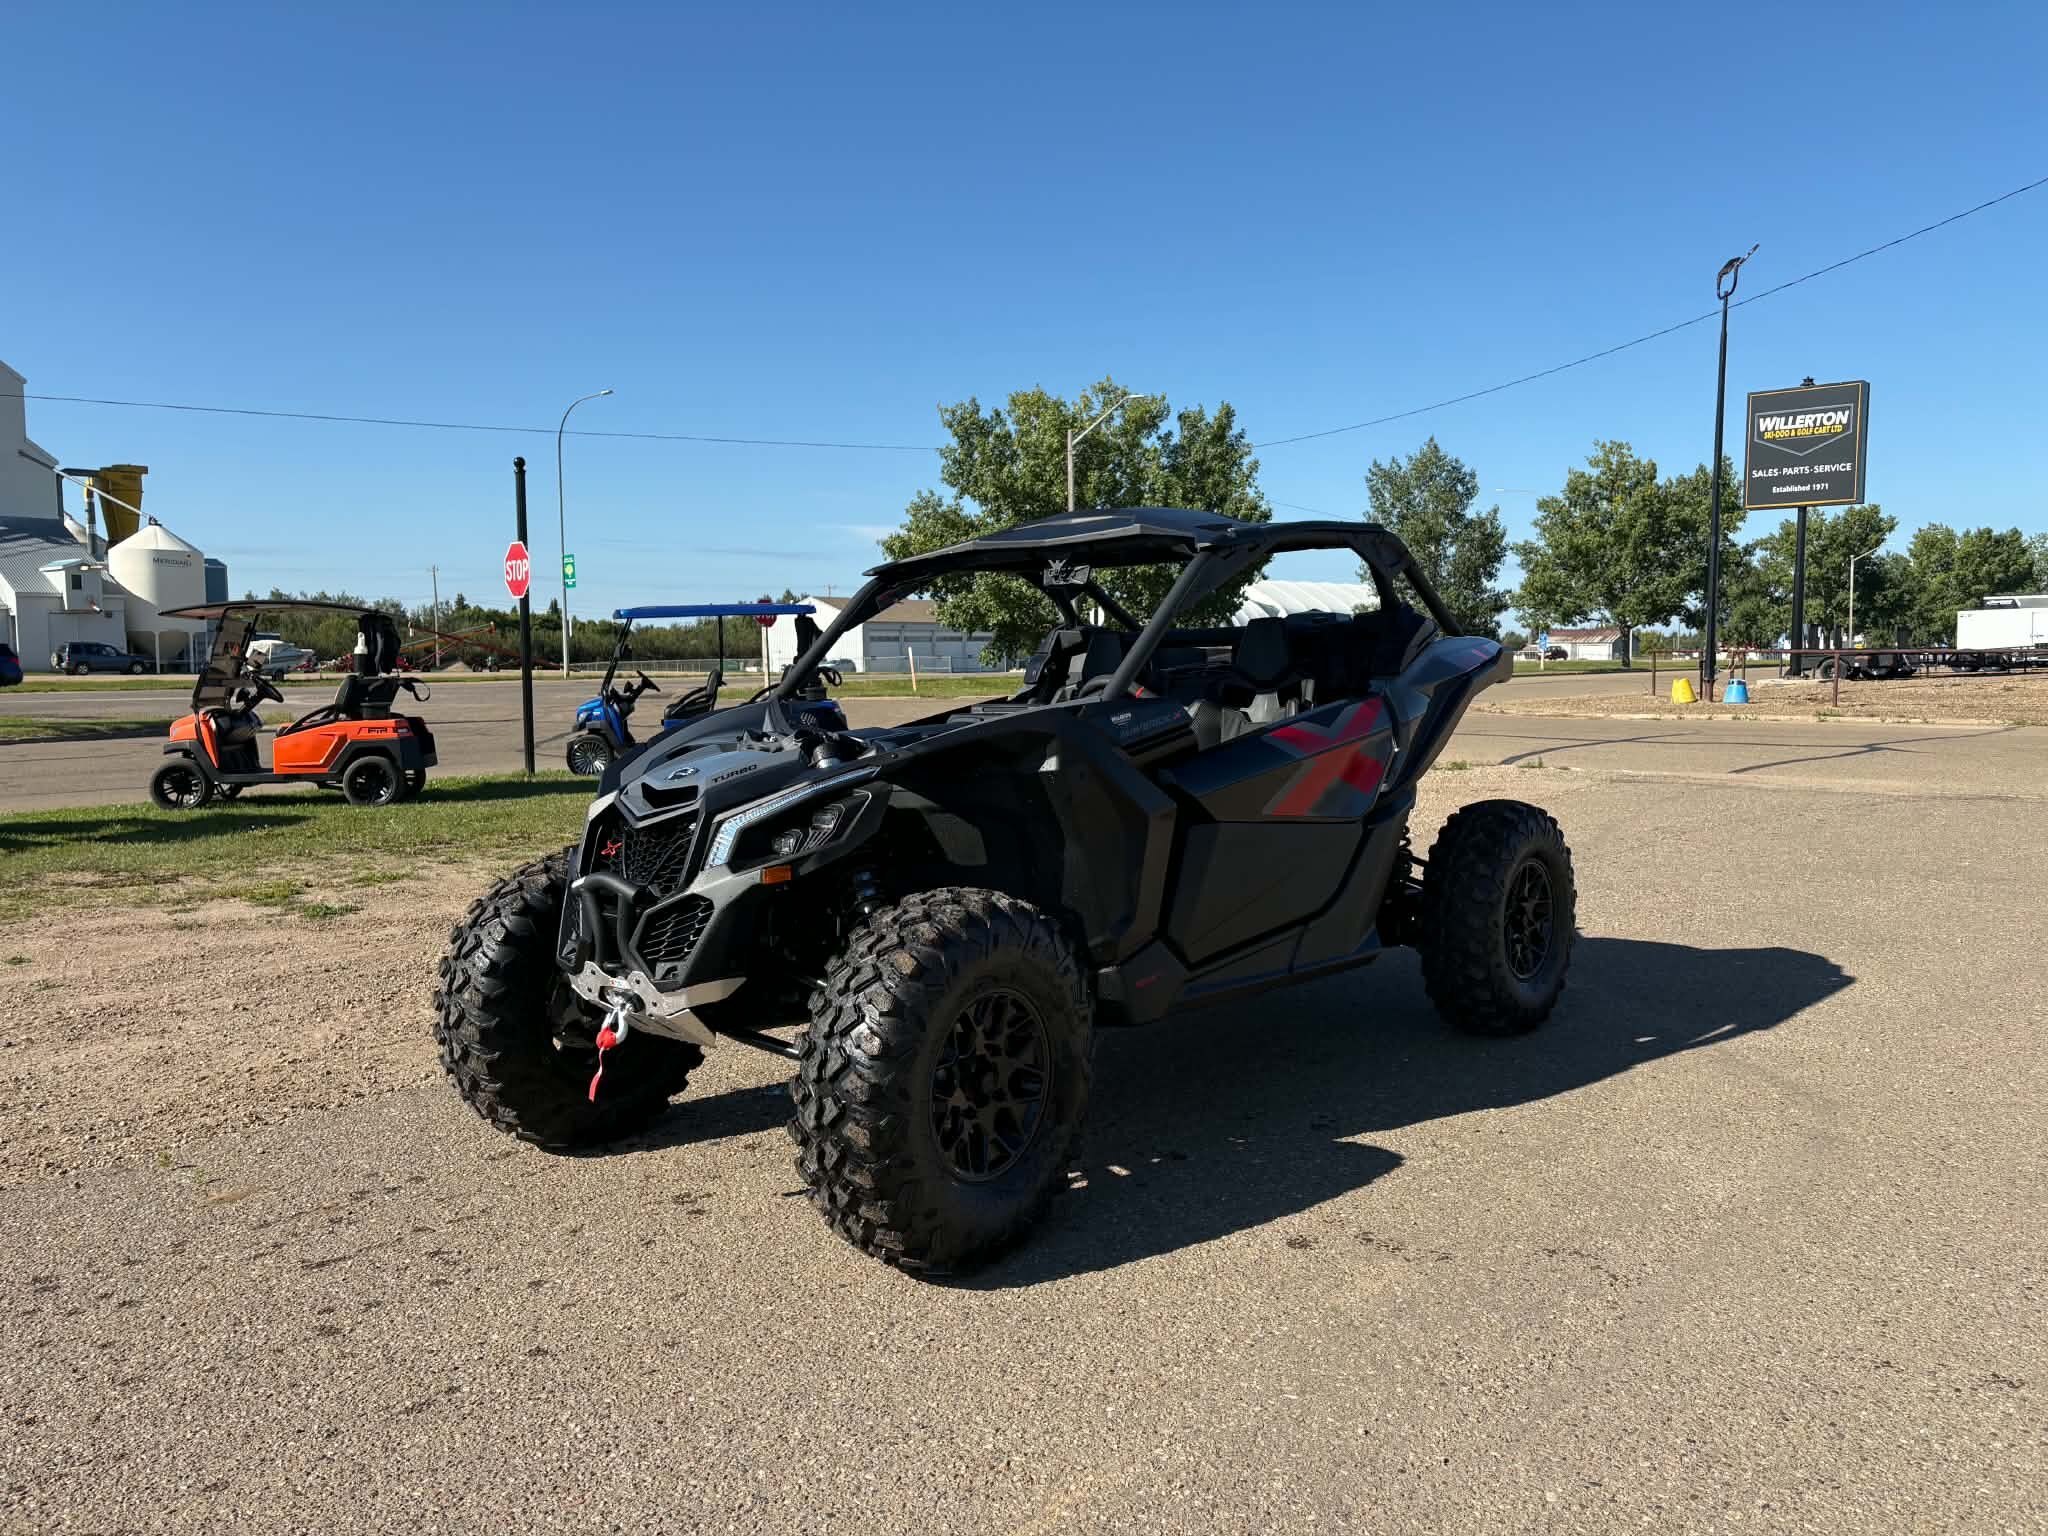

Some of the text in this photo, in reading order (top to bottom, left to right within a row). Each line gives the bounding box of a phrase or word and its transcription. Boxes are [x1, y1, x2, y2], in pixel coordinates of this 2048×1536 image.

[1759, 410, 1850, 432] WILLERTON
[1772, 482, 1829, 494] Established 1971
[506, 559, 528, 581] STOP
[712, 764, 757, 782] TURBO
